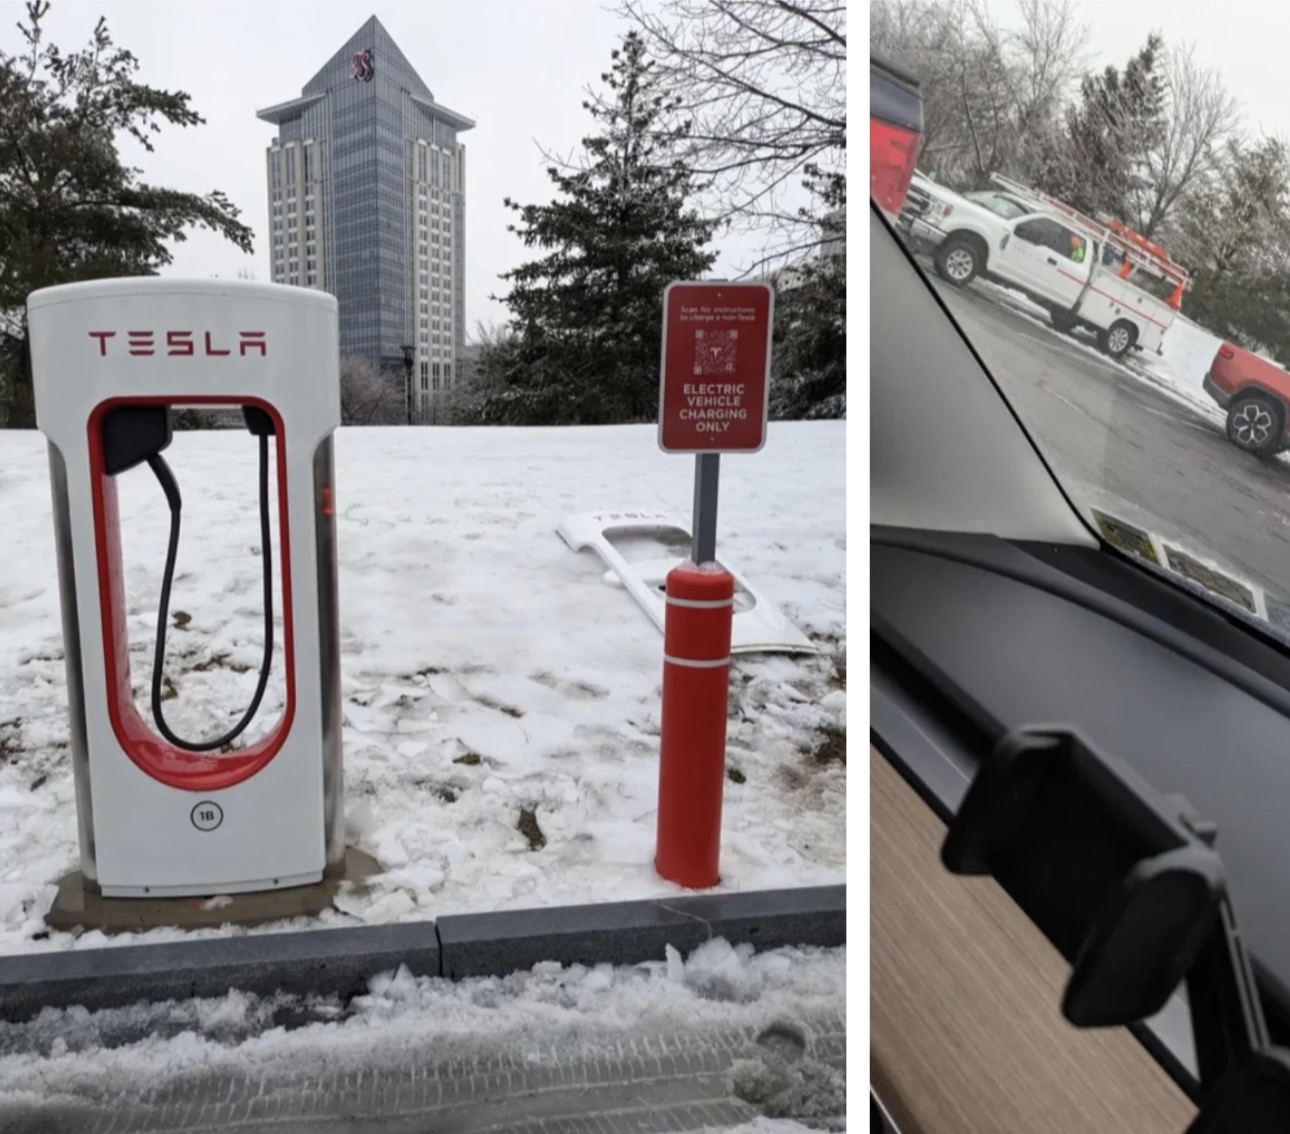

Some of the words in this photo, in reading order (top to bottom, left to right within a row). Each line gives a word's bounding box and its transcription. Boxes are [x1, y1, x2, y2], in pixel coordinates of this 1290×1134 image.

[689, 314, 714, 322] charge
[88, 331, 267, 356] TESLA
[683, 384, 745, 395] ELECTRIC
[687, 396, 741, 406] VEHICLE
[679, 408, 747, 419] CHARGING
[695, 421, 730, 432] ONLY
[200, 810, 215, 821] 1B
